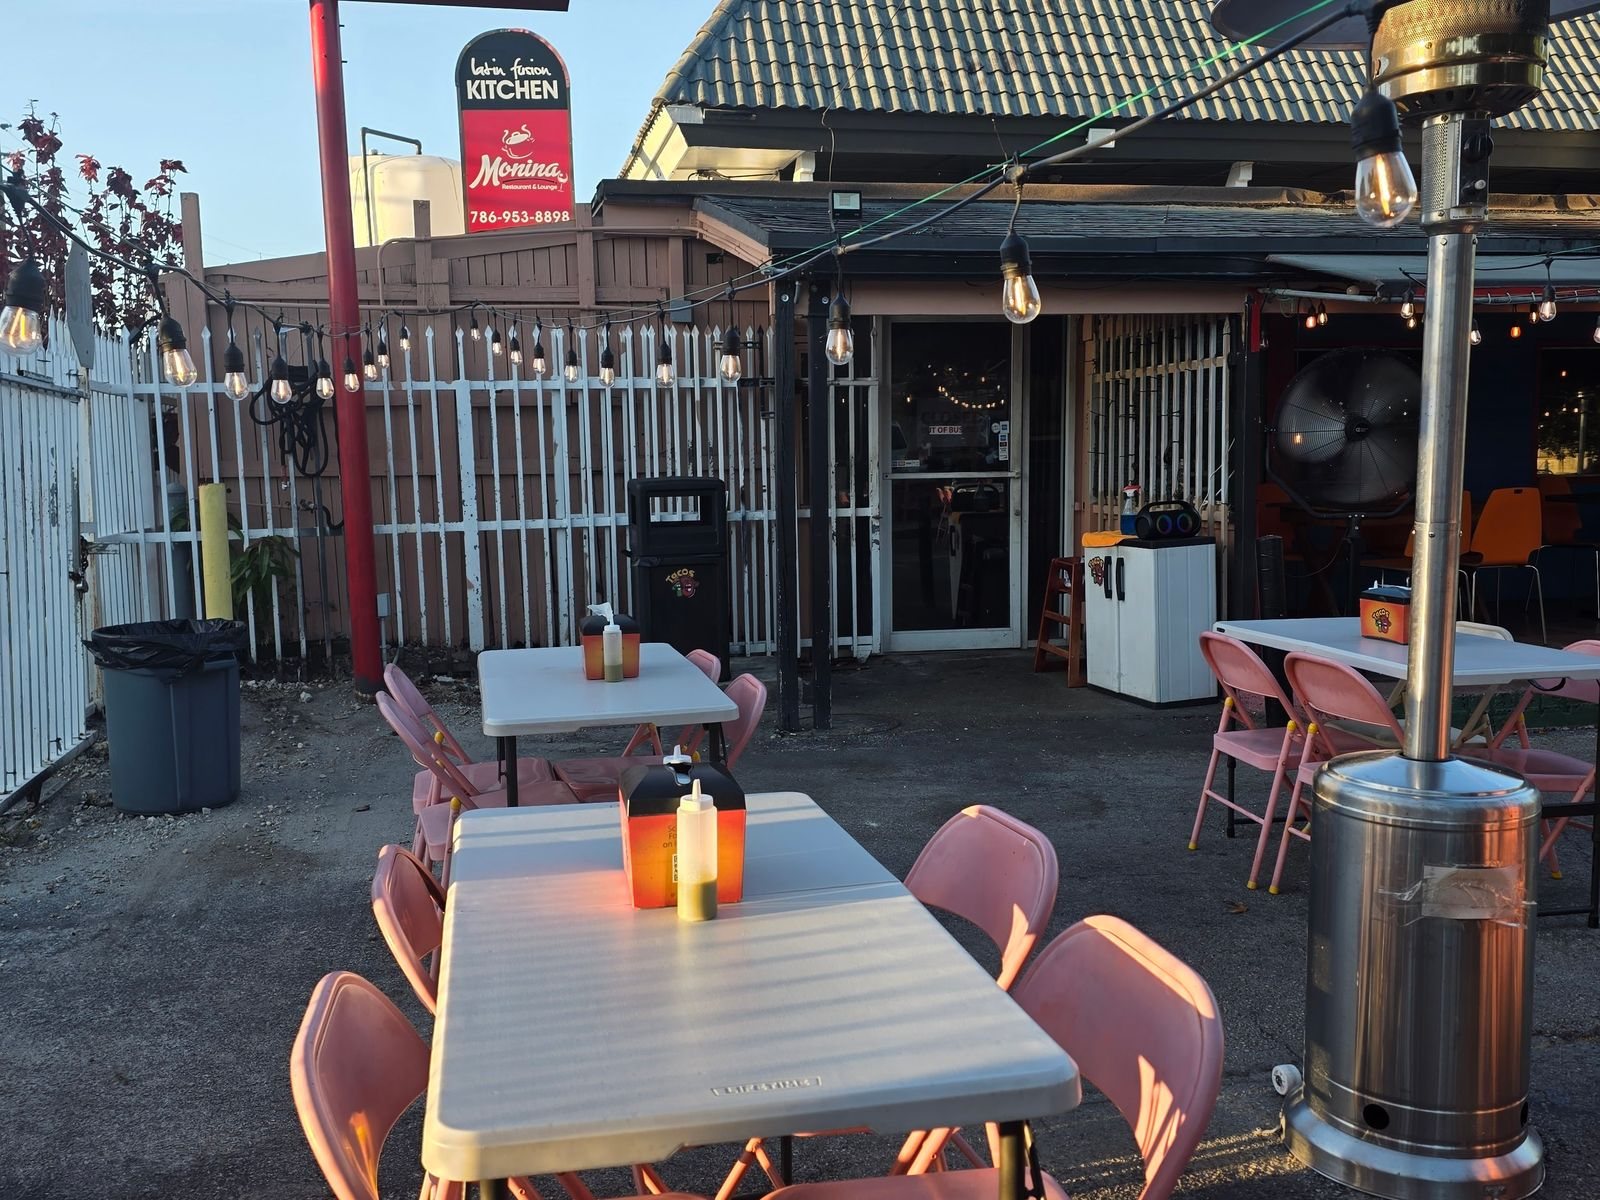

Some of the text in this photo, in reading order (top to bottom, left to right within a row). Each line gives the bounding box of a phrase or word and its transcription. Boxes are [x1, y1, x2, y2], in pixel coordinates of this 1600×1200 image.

[510, 57, 552, 80] fusion
[466, 79, 559, 100] KITCHEN
[469, 154, 561, 188] Monina
[470, 210, 570, 224] 786-953-8898
